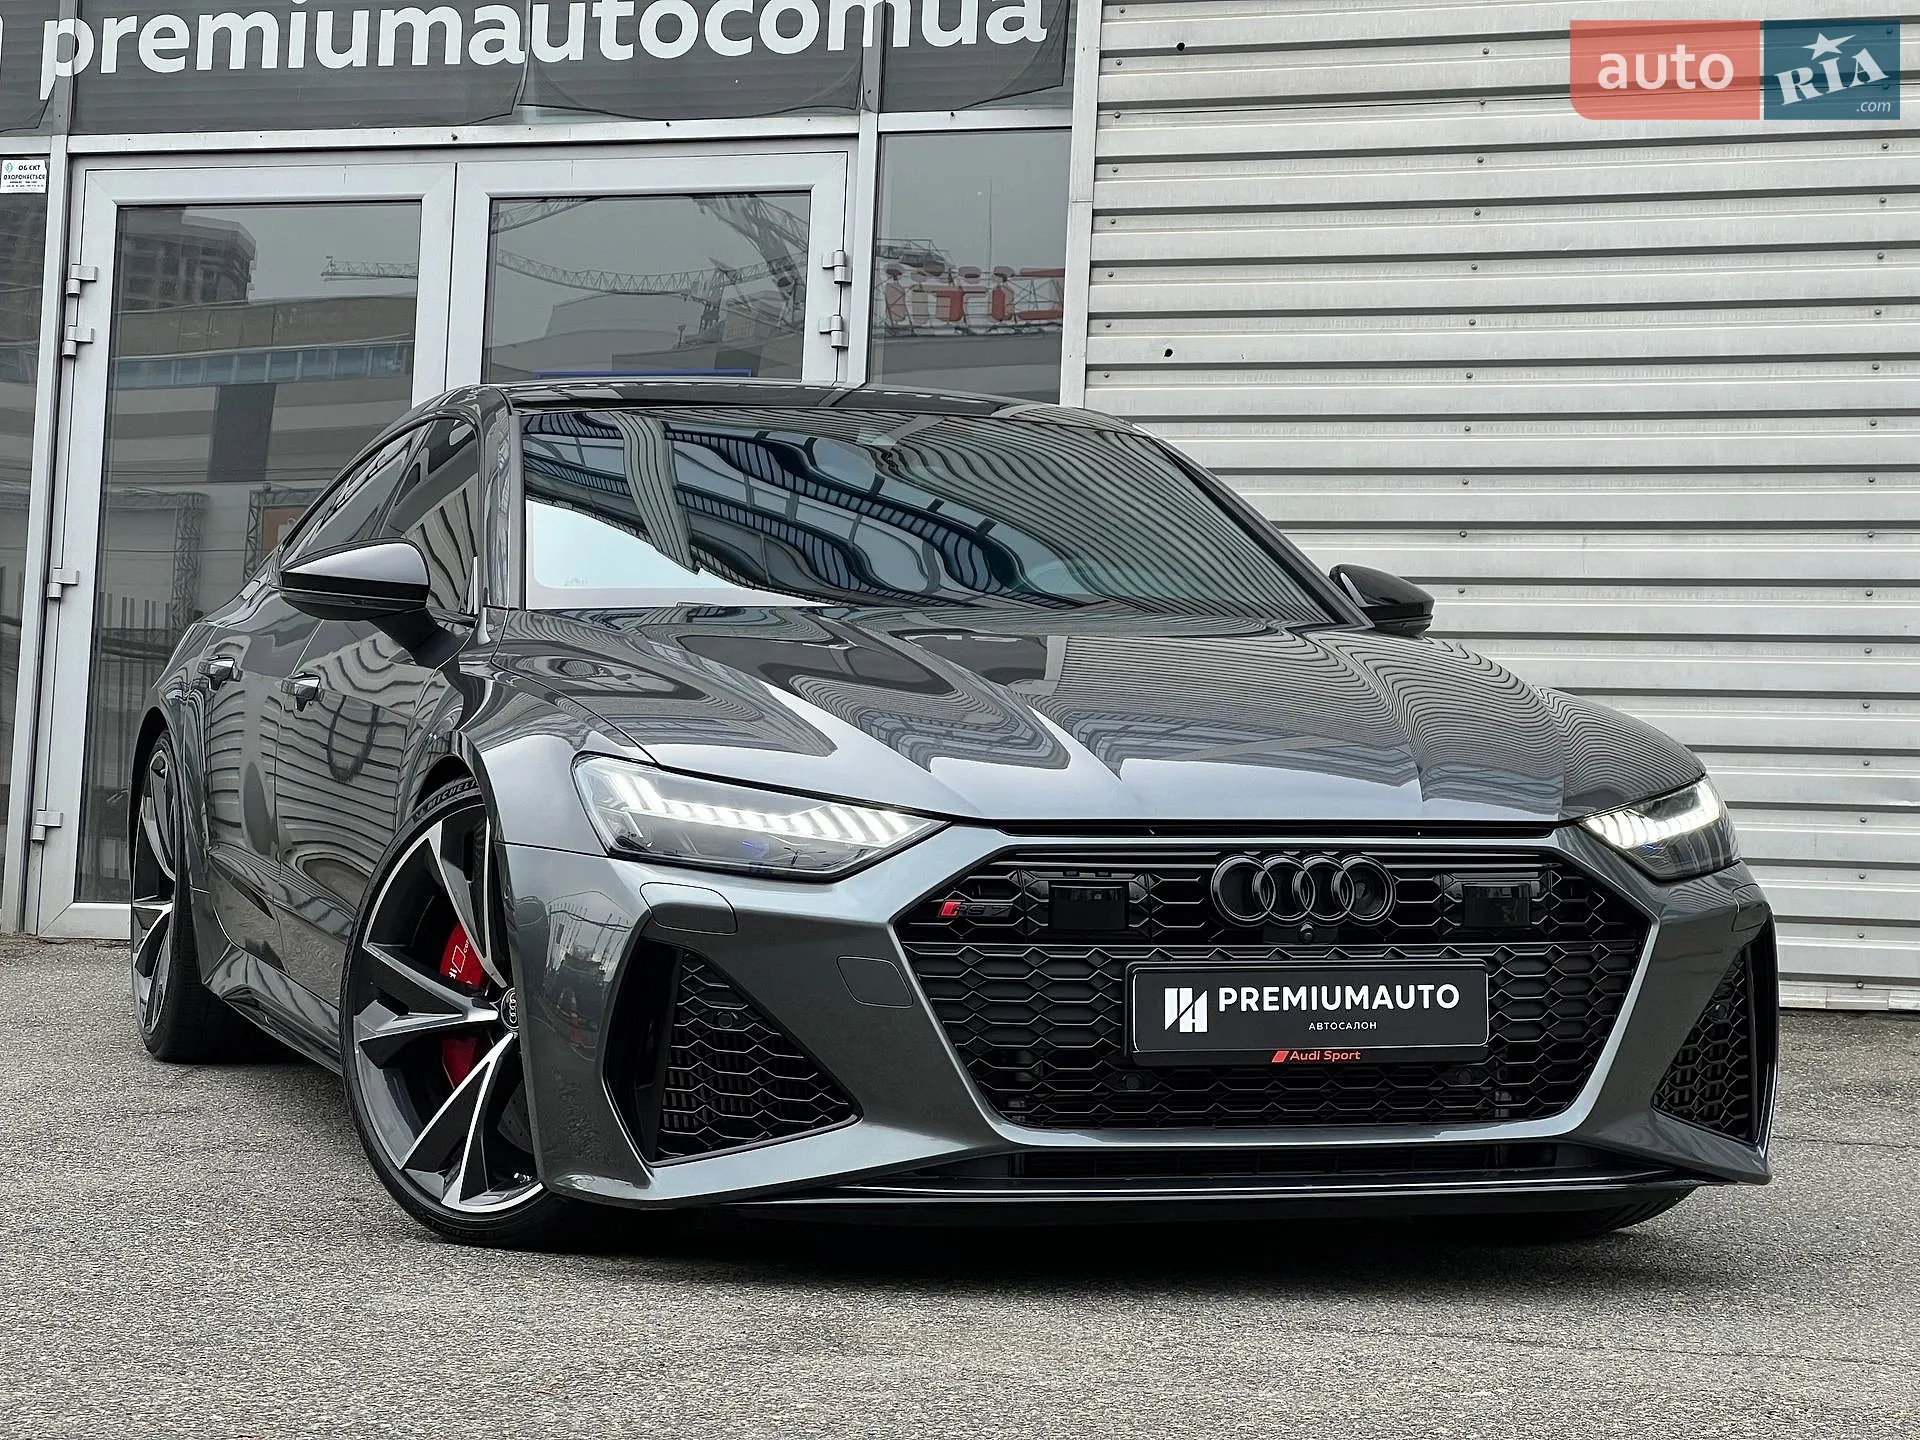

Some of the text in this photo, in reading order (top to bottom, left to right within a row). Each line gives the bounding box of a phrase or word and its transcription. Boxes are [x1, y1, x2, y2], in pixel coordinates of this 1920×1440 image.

[427, 780, 479, 810] MICHELI
[1217, 983, 1461, 1012] PREMIUMAUTO
[1308, 1020, 1378, 1031] АВТОСАЛОН
[1289, 1049, 1362, 1063] Audi Sport
